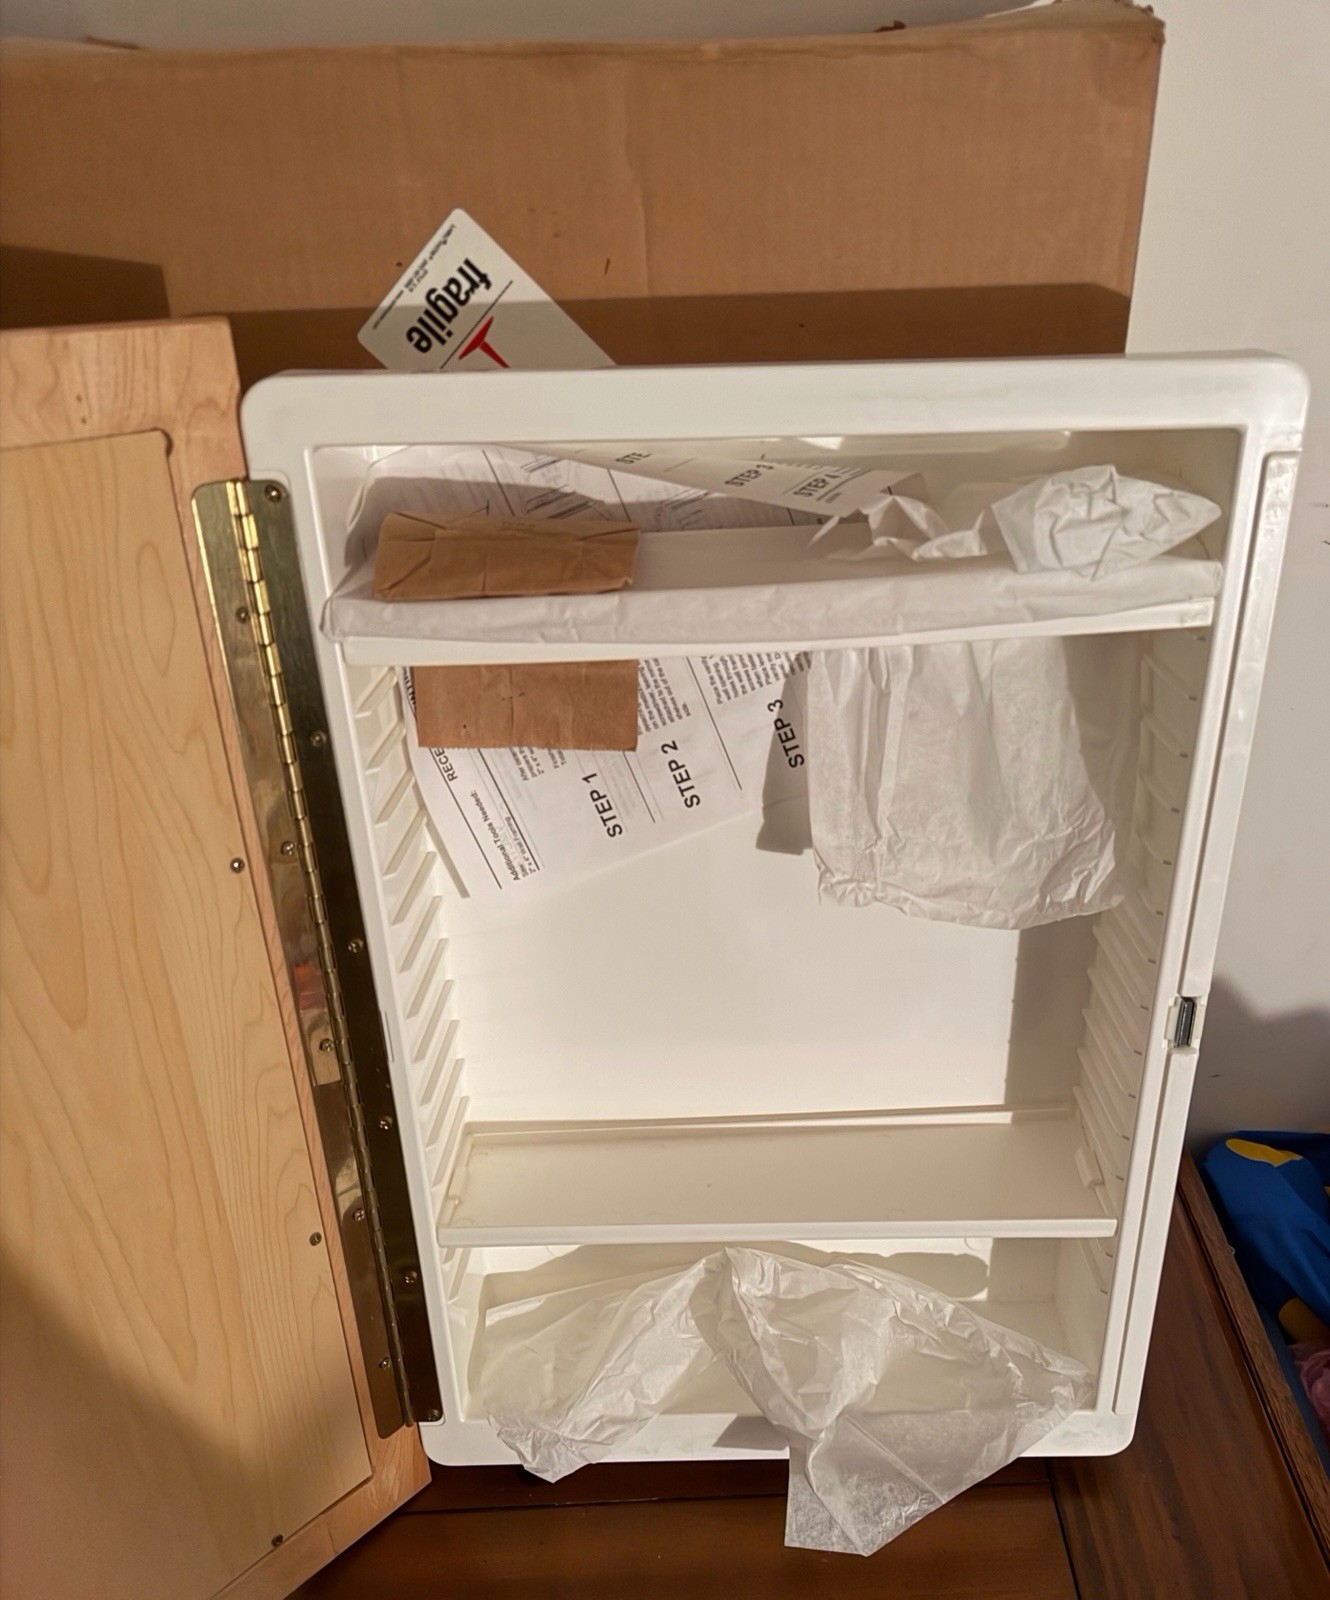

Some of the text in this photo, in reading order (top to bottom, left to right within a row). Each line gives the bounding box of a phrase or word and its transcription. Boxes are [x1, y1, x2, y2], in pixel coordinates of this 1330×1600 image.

[405, 258, 493, 354] fragile
[724, 468, 763, 487] STEP
[793, 478, 829, 497] STEP
[657, 667, 665, 677] the
[734, 671, 743, 683] wall
[744, 669, 756, 691] screws
[754, 671, 763, 688] when
[762, 667, 772, 685] Place
[652, 678, 660, 689] the
[664, 685, 673, 696] out
[729, 680, 739, 698] holes
[713, 686, 723, 704] Place
[647, 709, 655, 721] the
[659, 696, 675, 723] attached
[670, 696, 683, 720] shelves
[767, 699, 805, 769] STEP 3
[518, 767, 529, 781] After
[522, 754, 537, 778] prepare
[660, 740, 701, 808] STEP 2
[581, 773, 623, 838] STEP 1
[470, 790, 520, 881] Additional Tools Needed:
[505, 816, 520, 841] Framing
